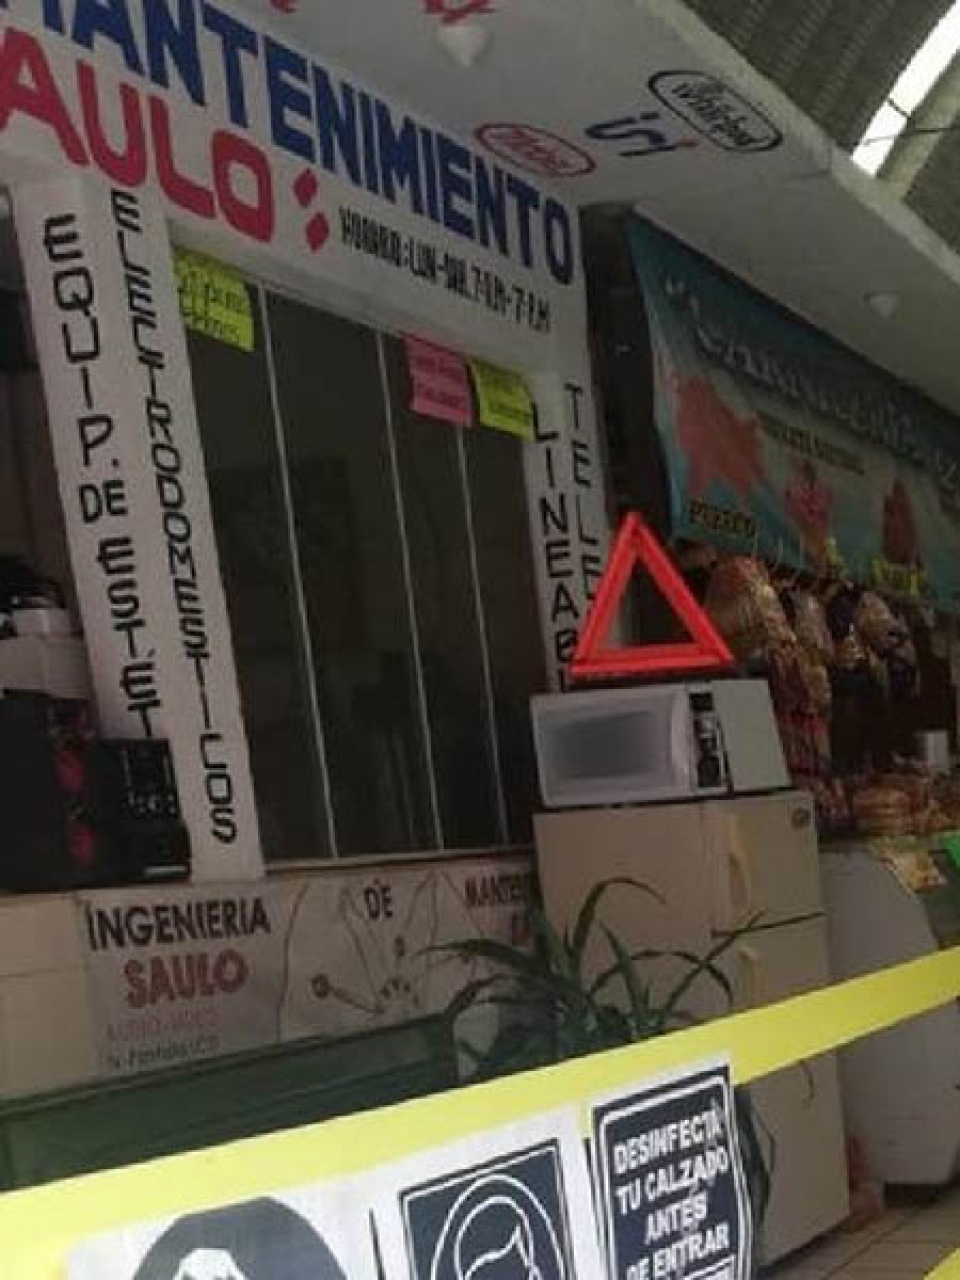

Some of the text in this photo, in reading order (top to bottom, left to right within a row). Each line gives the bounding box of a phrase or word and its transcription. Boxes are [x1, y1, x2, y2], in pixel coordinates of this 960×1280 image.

[79, 479, 128, 523] DE
[110, 187, 238, 844] ELECTRODOMESTICOS
[88, 897, 271, 951] INGENIERIA
[124, 949, 248, 1008] SAULO
[614, 1099, 724, 1174] DESINFECTA
[616, 1146, 729, 1216] TU CALZADO
[644, 1190, 709, 1246] ANTES
[653, 1221, 730, 1280] ENTRAR
